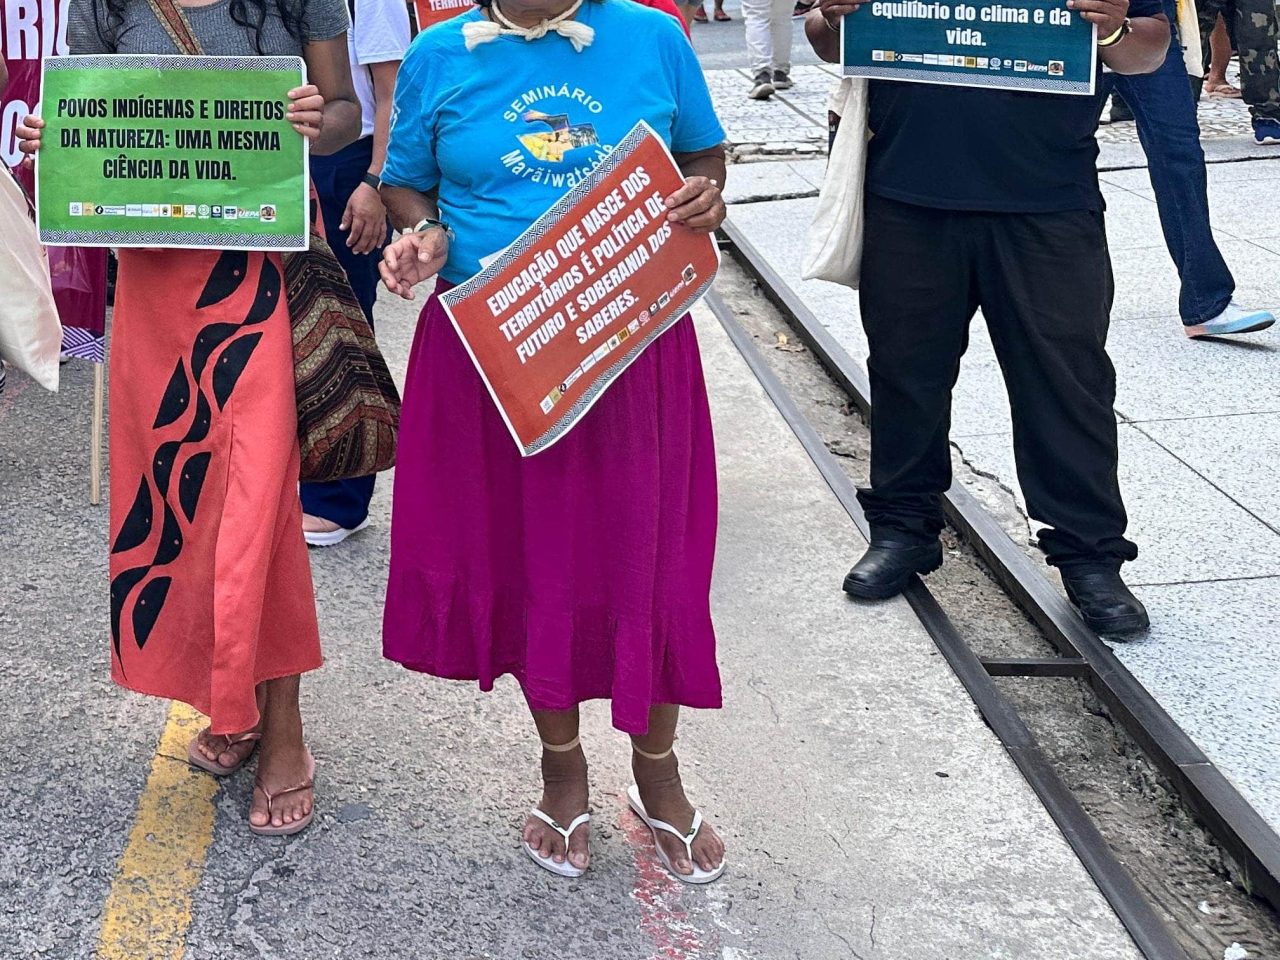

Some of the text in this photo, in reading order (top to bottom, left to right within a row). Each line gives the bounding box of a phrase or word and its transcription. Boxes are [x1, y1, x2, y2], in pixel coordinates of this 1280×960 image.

[872, 0, 1071, 26] equilíbrio do clima e da
[946, 27, 987, 47] vida.
[58, 94, 284, 120] POVOS INDÍGENAS E DIREITOS
[503, 82, 603, 123] SEMINÁRIO
[61, 128, 281, 151] DA NATUREZA: UMA MESMA
[103, 154, 237, 181] CIÊNCIA DA VIDA.
[486, 166, 651, 318] EDUCAÇÃO QUE NASCE DOS
[499, 191, 668, 343] TERRITÓRIOS É POLÍTICA DE
[515, 311, 567, 365] FUTURO
[565, 302, 579, 322] E
[576, 244, 650, 313] SOBERANIA
[649, 220, 672, 255] DOS
[575, 288, 640, 345] SABERES.
